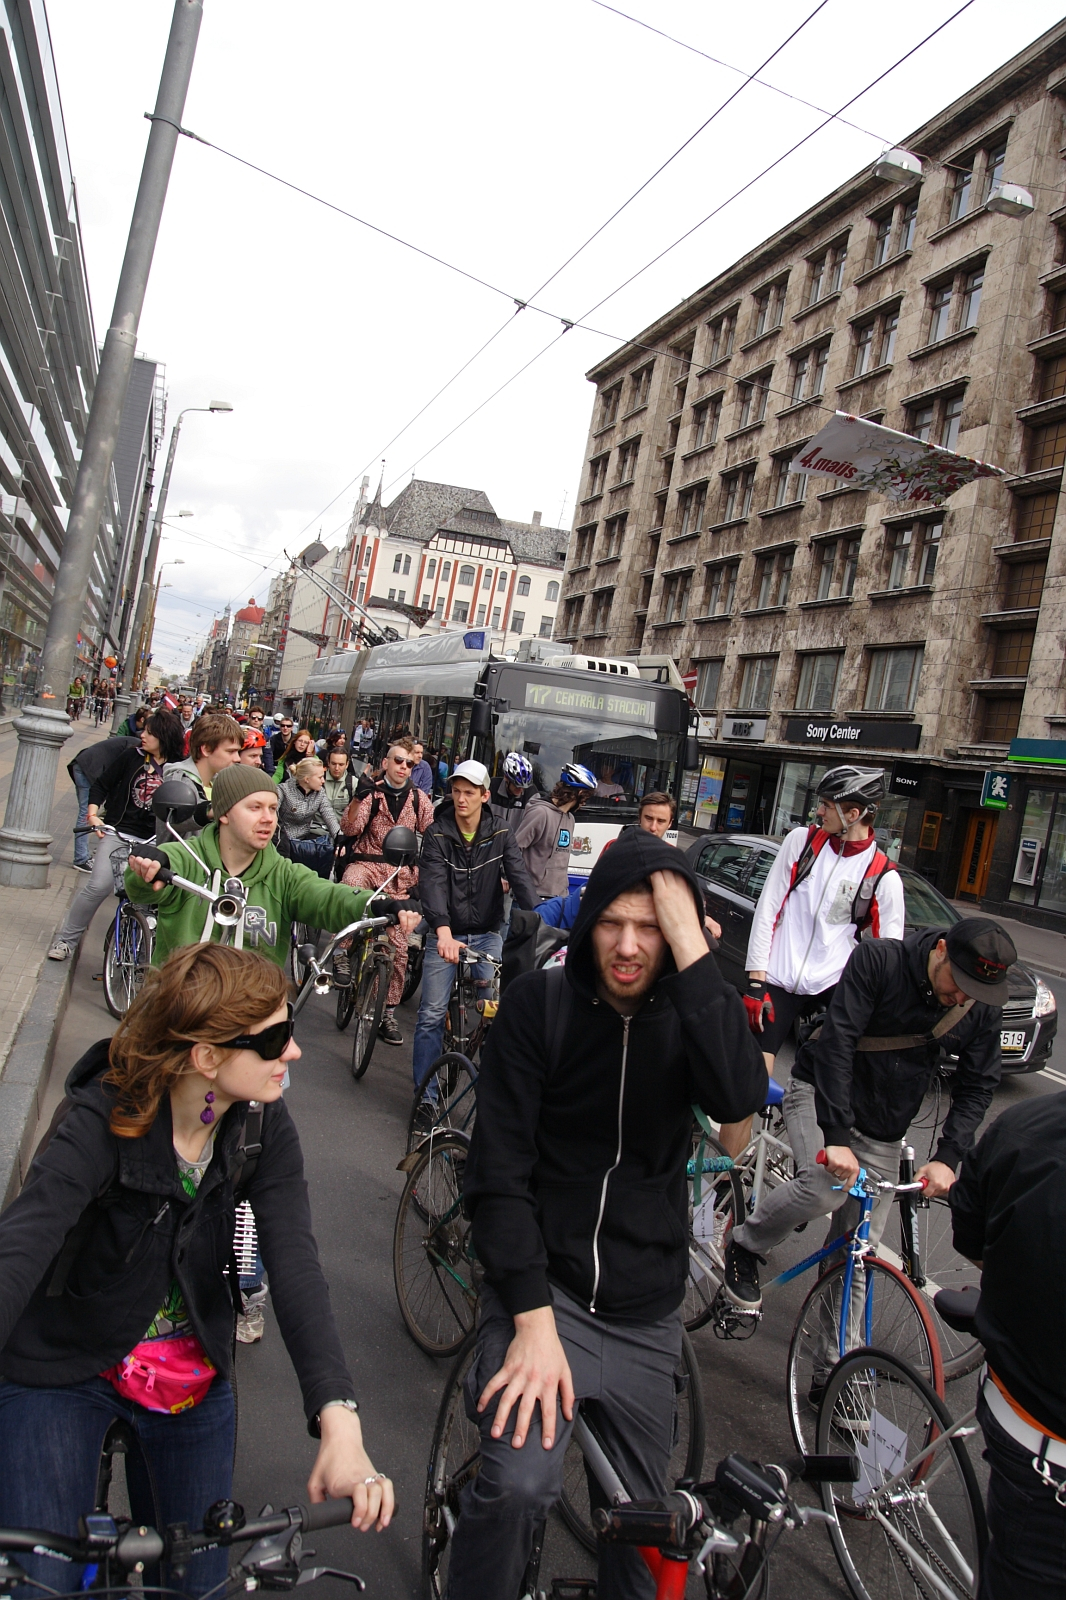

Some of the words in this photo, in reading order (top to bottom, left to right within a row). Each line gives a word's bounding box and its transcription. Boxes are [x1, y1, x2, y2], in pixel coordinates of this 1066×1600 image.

[530, 686, 552, 704] 17
[607, 698, 646, 716] STACIJA
[806, 723, 827, 742] Sony
[829, 724, 861, 740] Center
[895, 776, 918, 786] SONY
